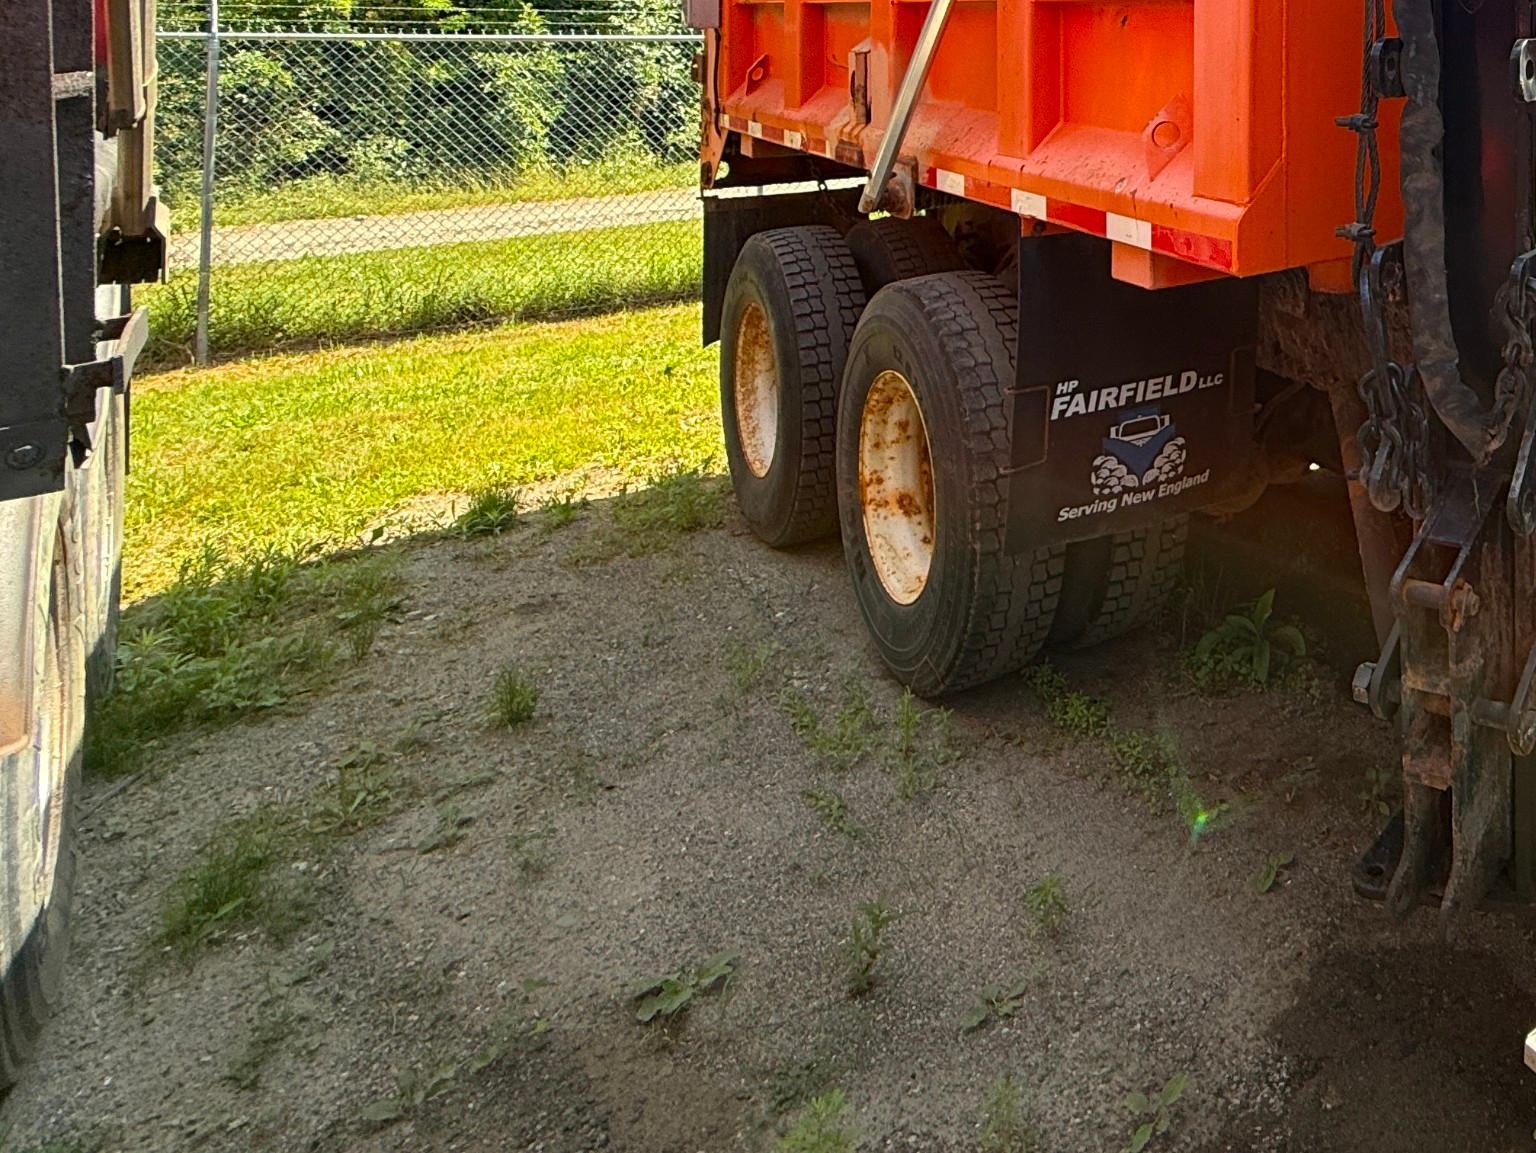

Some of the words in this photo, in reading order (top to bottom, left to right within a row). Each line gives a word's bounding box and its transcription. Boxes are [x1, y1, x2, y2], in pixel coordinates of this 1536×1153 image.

[1051, 370, 1198, 420] FAIRFIELD
[1198, 373, 1223, 389] LLC
[1057, 380, 1079, 395] HP
[1058, 500, 1118, 522] Serving
[1121, 489, 1155, 508] New
[1158, 470, 1210, 498] England
